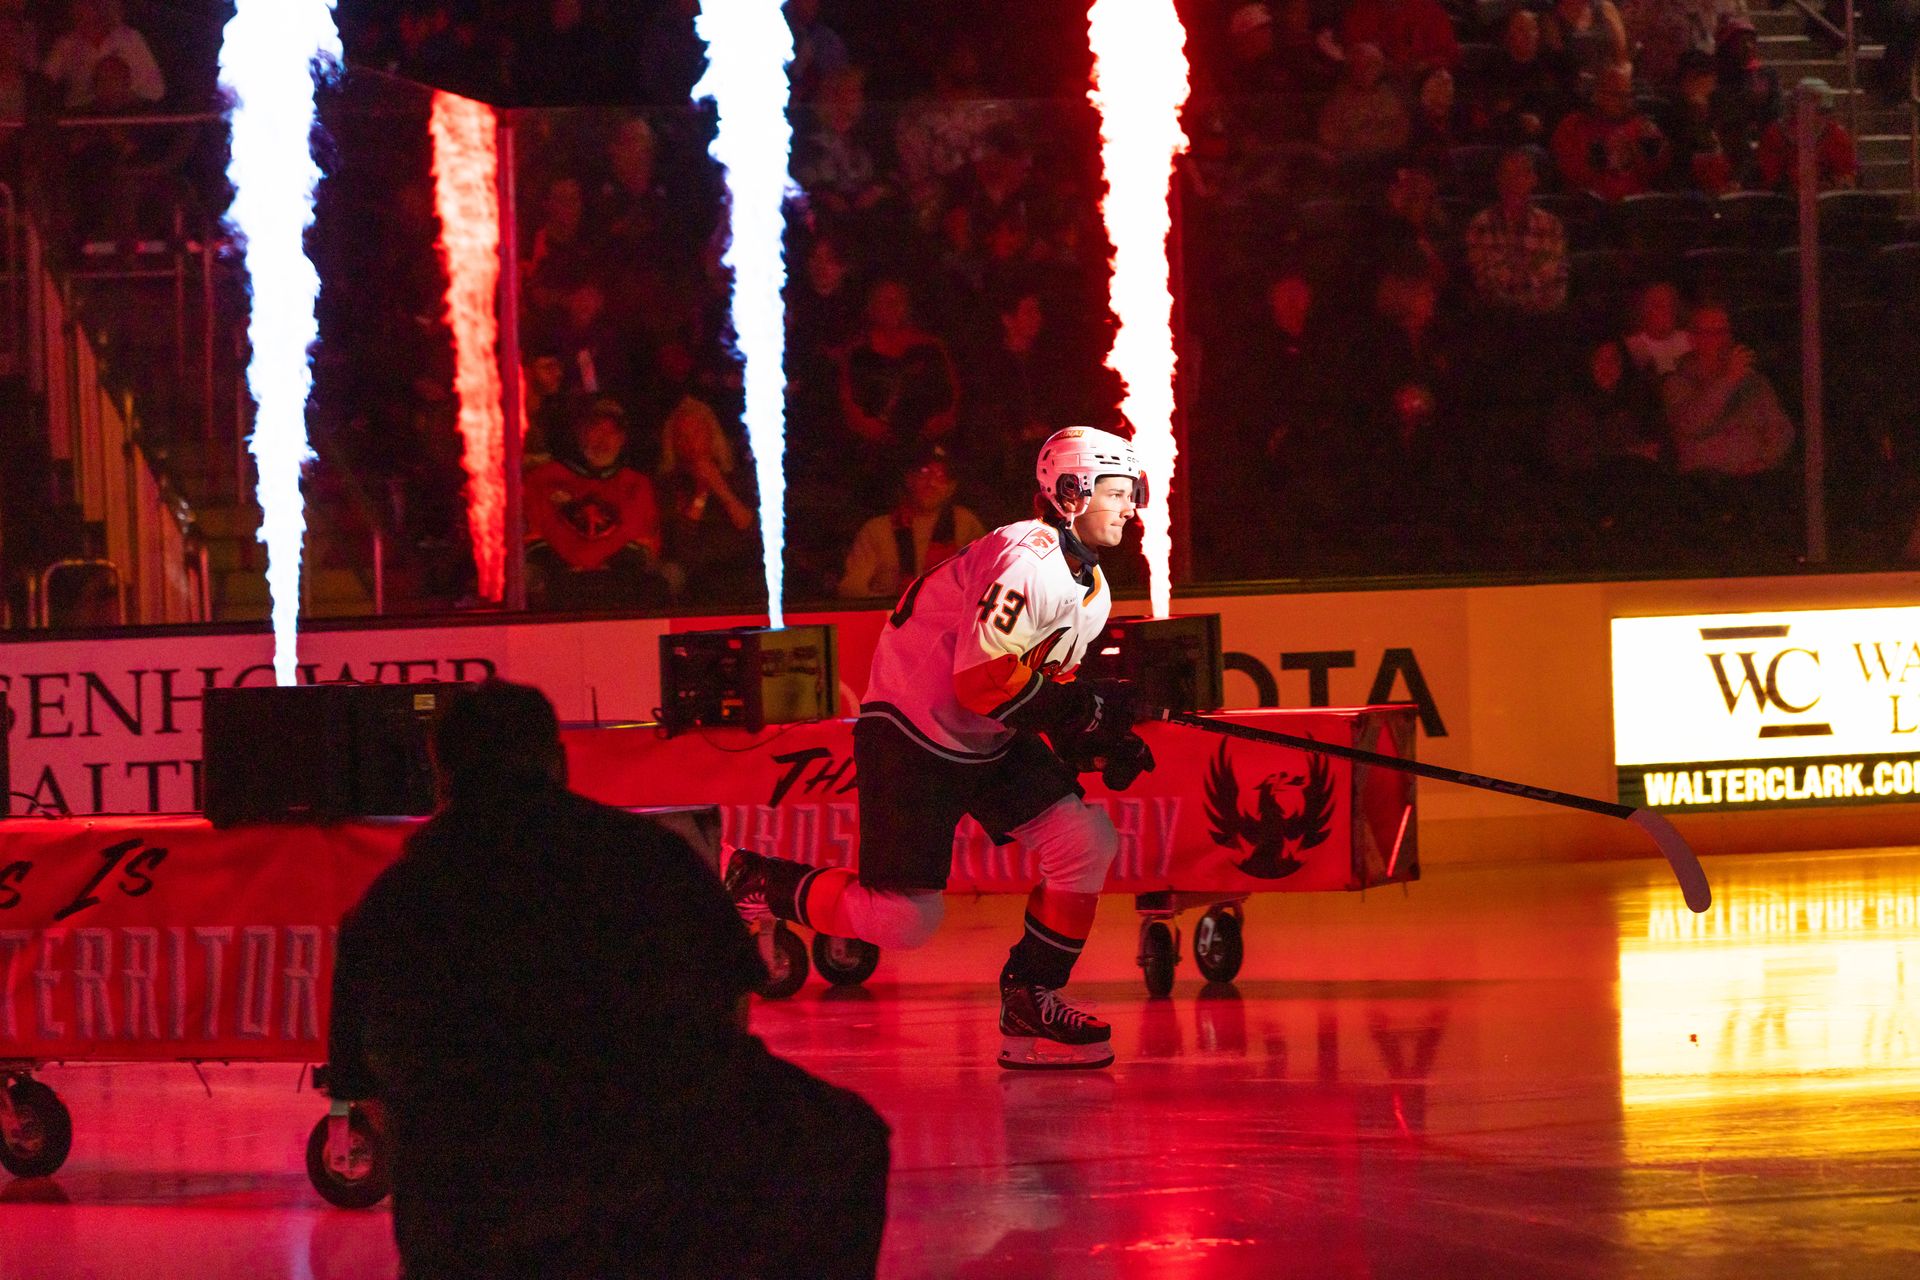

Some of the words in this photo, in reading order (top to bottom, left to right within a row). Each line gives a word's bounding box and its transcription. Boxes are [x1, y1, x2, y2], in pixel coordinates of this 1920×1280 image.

[979, 582, 1025, 635] 43
[1704, 647, 1822, 715] WC
[1643, 760, 1920, 807] WALTERCLARK.CO
[0, 924, 337, 1041] TERRITOR
